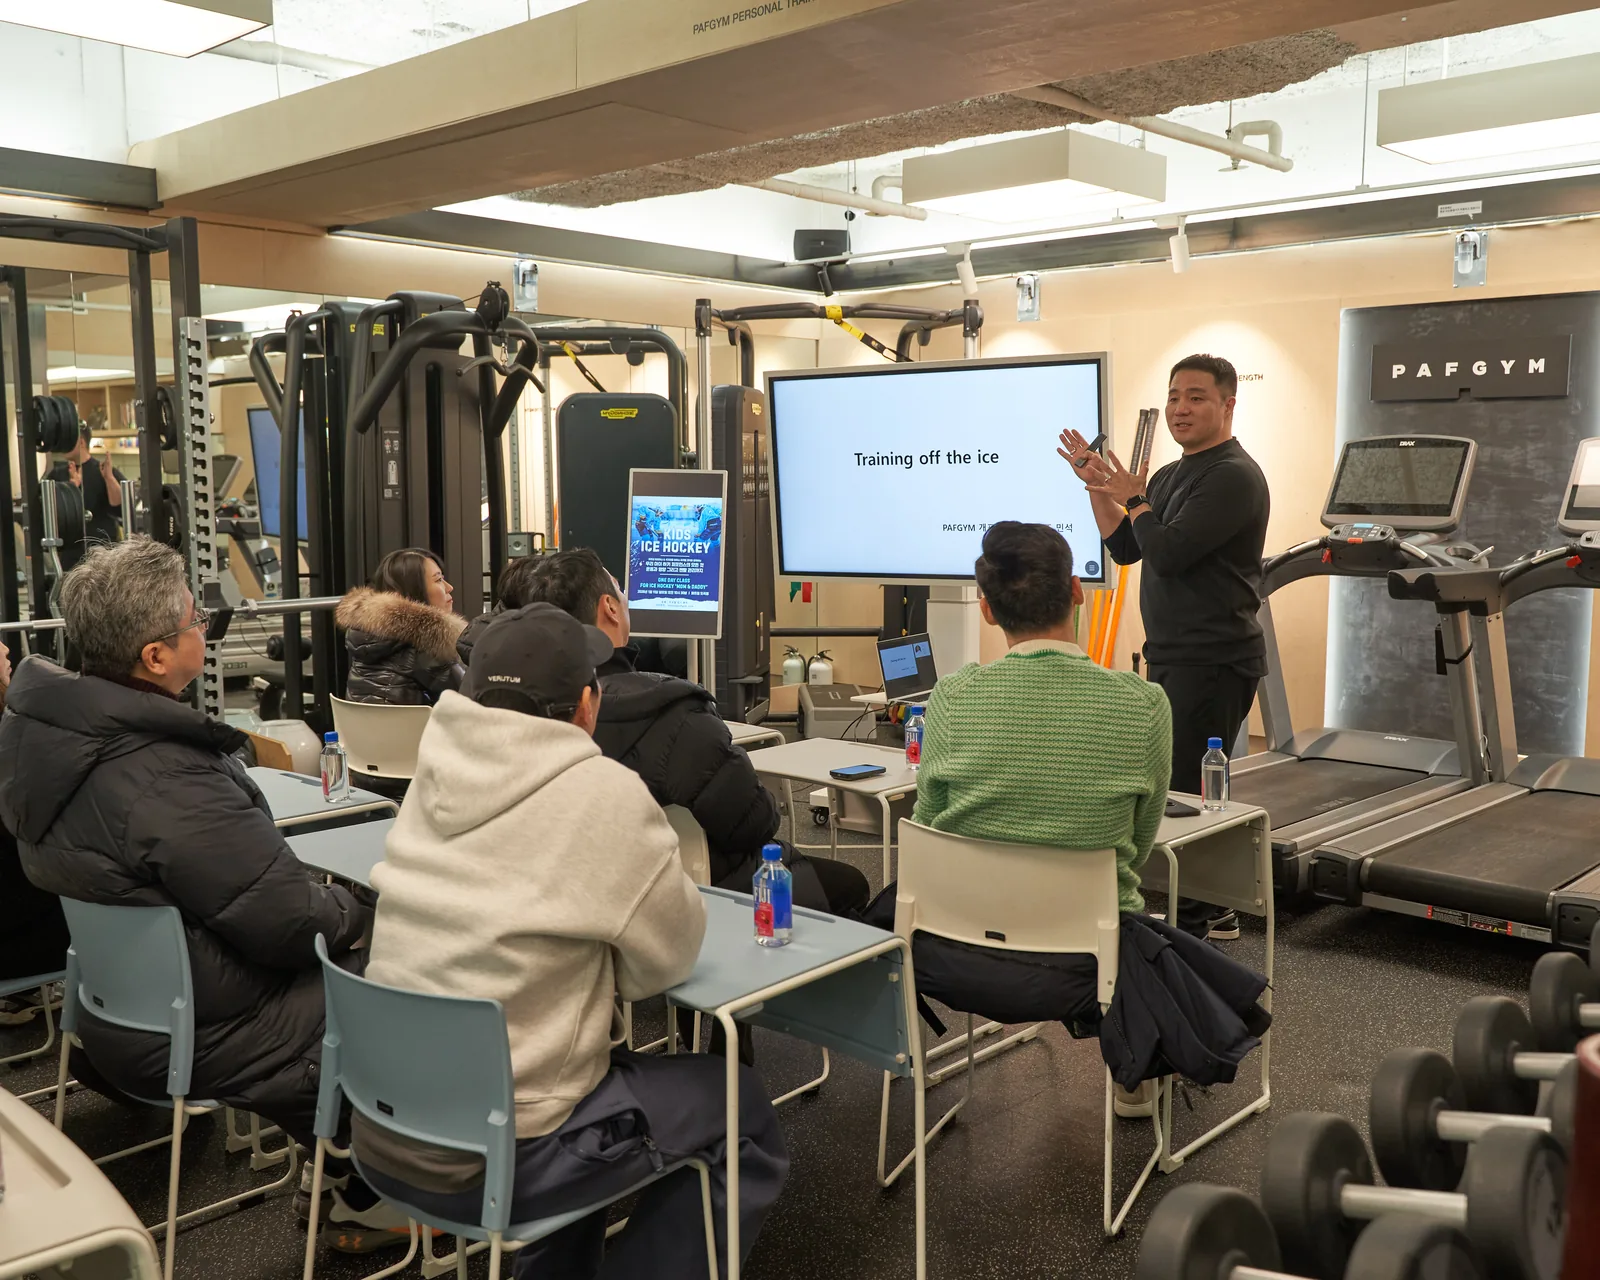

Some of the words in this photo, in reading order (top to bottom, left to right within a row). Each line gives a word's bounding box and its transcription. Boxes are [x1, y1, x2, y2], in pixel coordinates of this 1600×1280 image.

[692, 15, 730, 35] PAFGYM
[732, 1, 784, 24] PERSONAL
[1391, 358, 1546, 379] PAFGYM
[1238, 373, 1264, 381] ENGTH
[854, 451, 913, 470] Training
[919, 449, 941, 465] off
[946, 449, 971, 464] the
[977, 449, 999, 464] ice
[664, 529, 691, 540] KIDS
[942, 523, 976, 532] PAFGYM
[641, 540, 660, 552] ICE
[662, 541, 711, 554] HOCKEY
